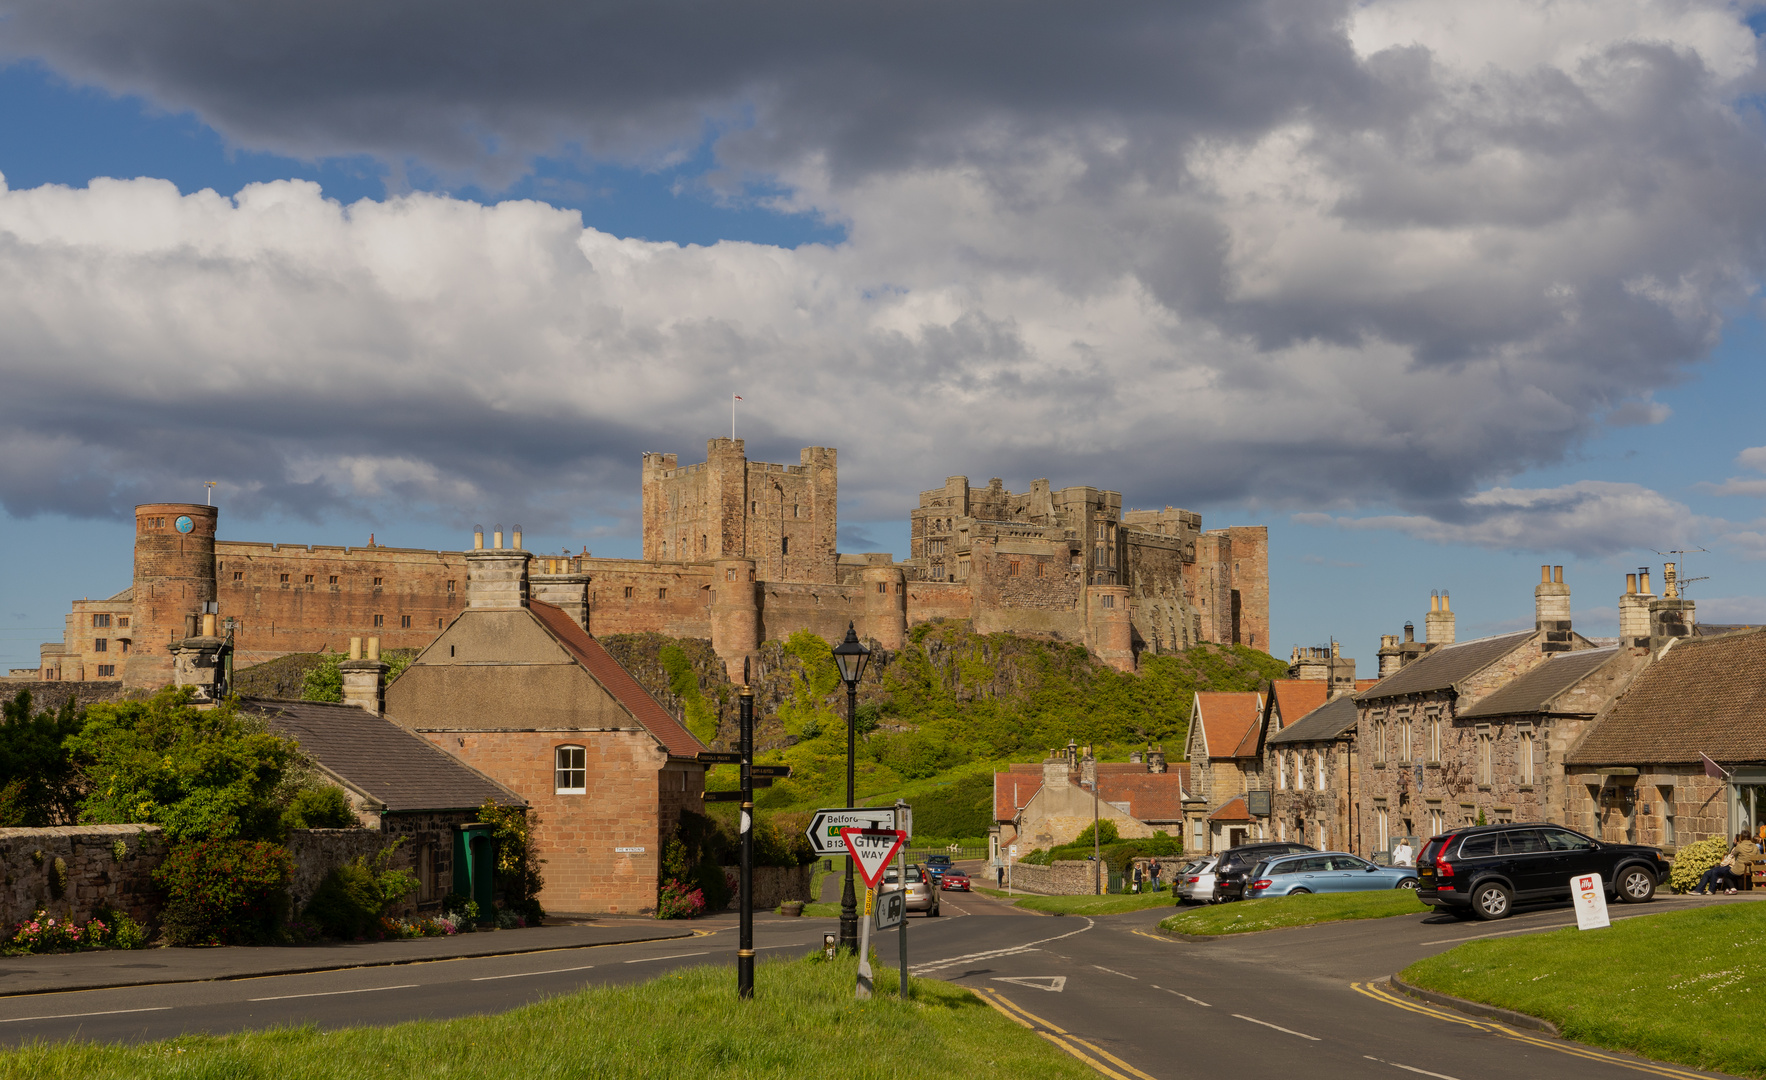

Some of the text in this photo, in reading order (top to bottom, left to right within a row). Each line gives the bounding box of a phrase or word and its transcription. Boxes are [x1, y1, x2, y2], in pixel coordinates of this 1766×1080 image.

[854, 836, 890, 848] GIVE
[861, 851, 884, 859] WAY
[1581, 879, 1592, 890] illy
